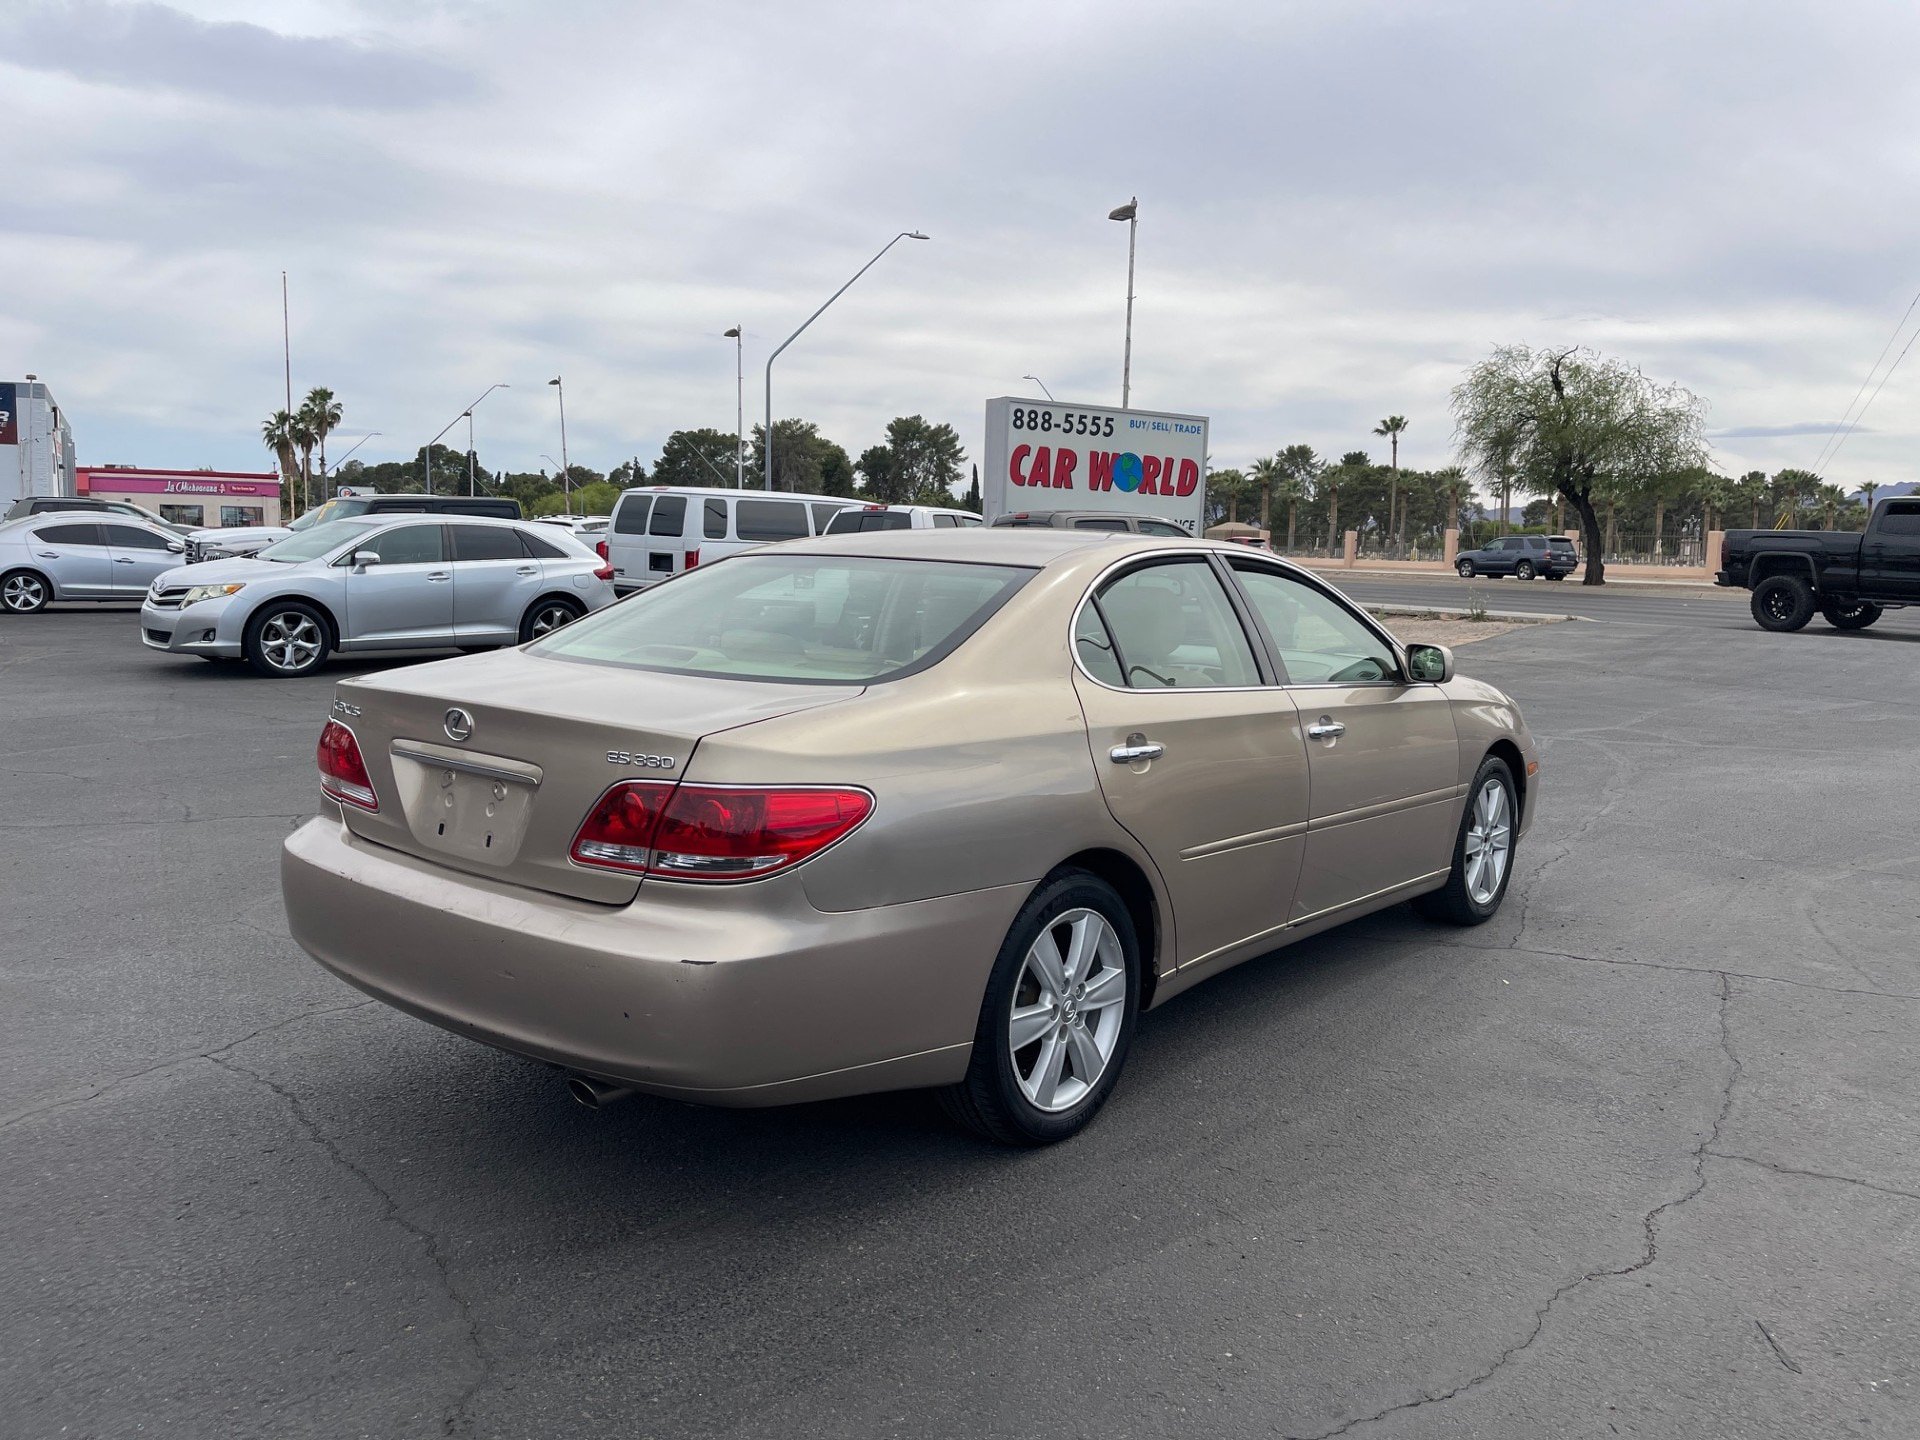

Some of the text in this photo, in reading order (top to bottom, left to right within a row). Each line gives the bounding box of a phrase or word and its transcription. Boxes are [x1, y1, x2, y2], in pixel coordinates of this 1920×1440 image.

[1013, 408, 1114, 437] 888-5555
[1174, 423, 1202, 435] TRADE
[1009, 443, 1199, 497] CAR WORLD
[164, 481, 175, 493] La
[606, 750, 675, 769] ES 330
